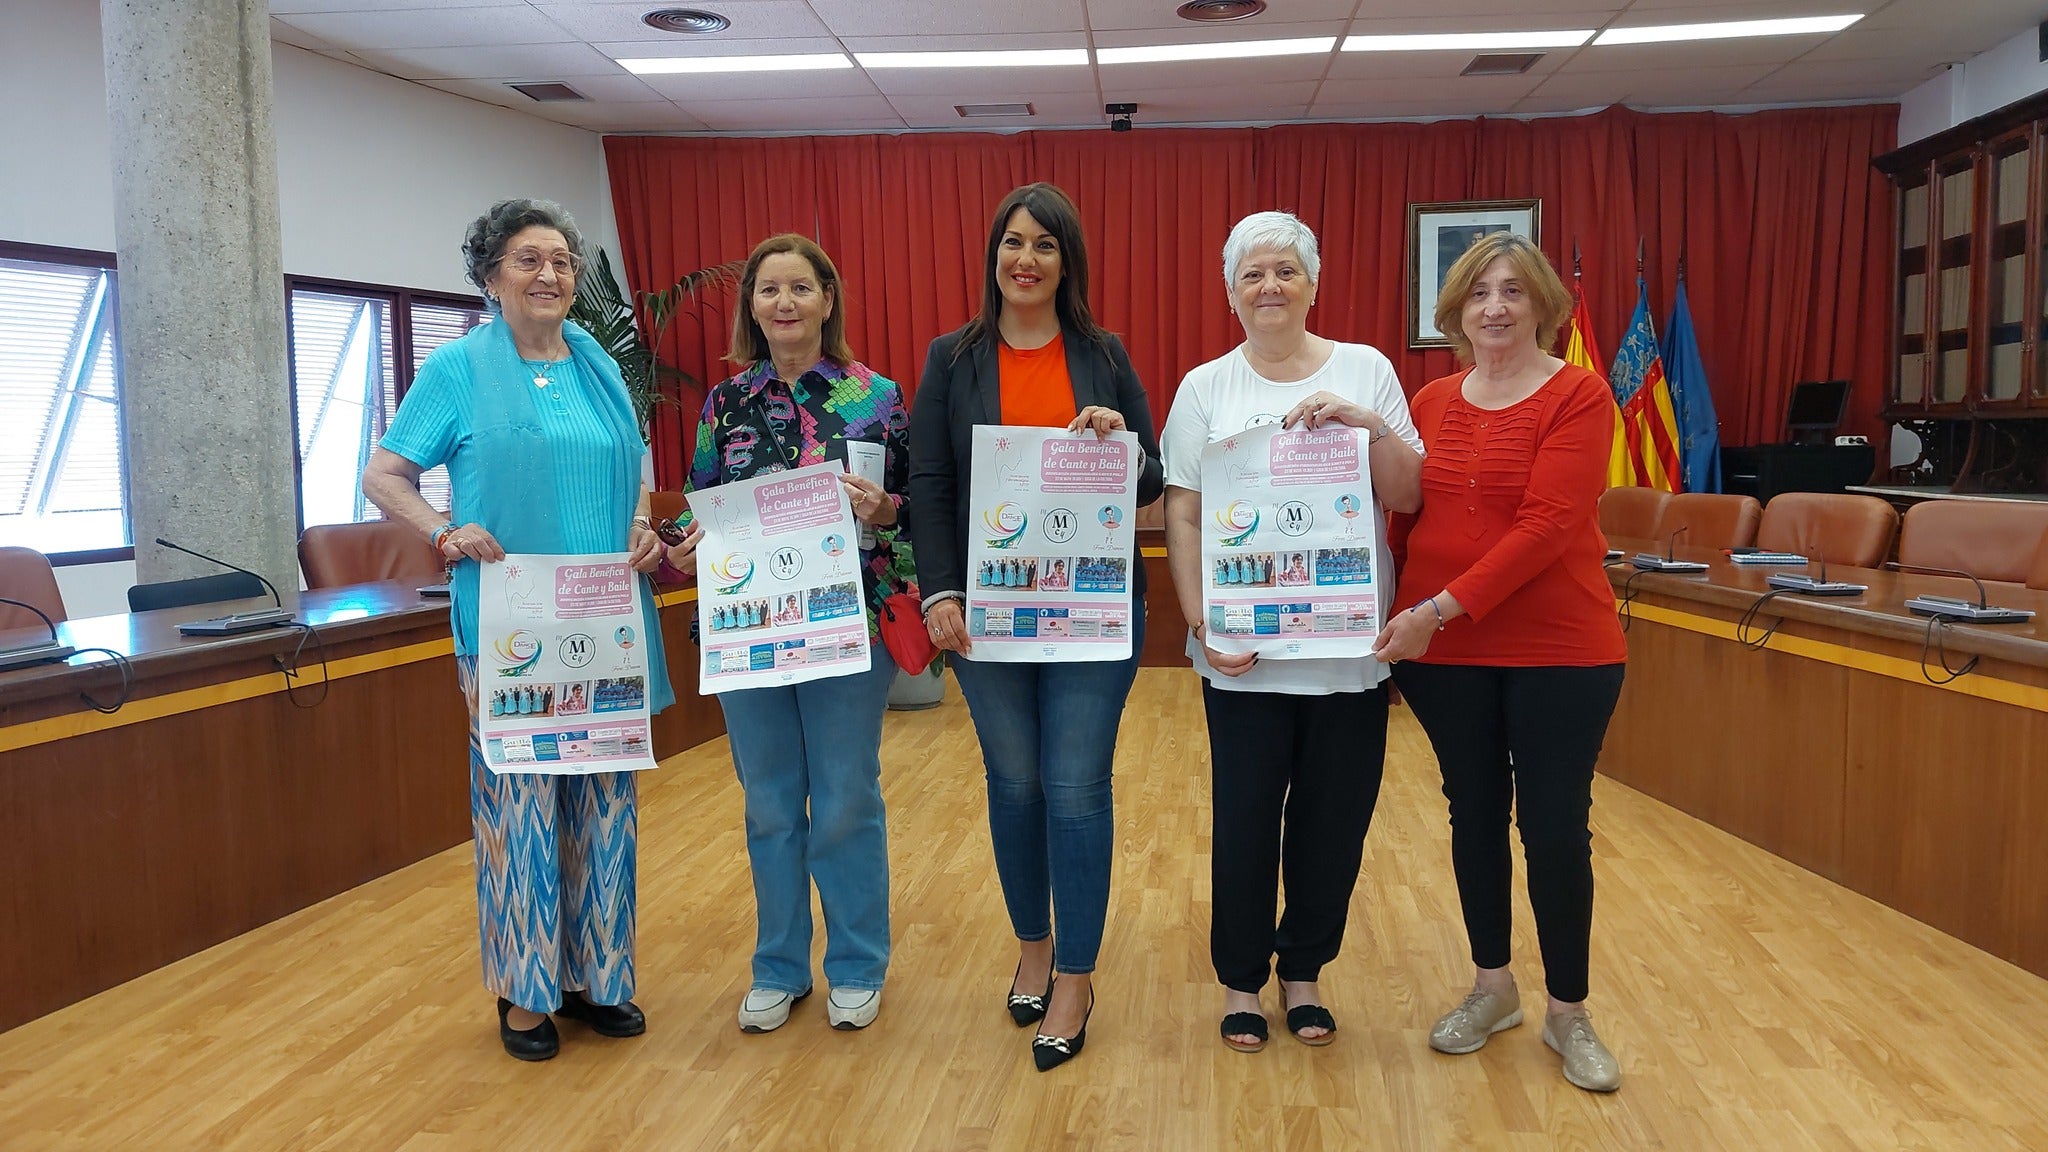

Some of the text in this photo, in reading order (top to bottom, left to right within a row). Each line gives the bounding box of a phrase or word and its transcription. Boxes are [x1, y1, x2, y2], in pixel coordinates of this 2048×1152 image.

[1278, 431, 1350, 449] Gala Benéfica
[1050, 441, 1120, 456] Gala Benéfica
[1272, 446, 1356, 463] de Cante y Baile
[1044, 457, 1126, 471] de Cante y Baile
[762, 476, 829, 500] Gala Benéfica
[760, 501, 773, 514] de
[773, 497, 802, 511] Cante
[804, 497, 811, 507] y
[812, 490, 838, 503] Baile
[1052, 514, 1068, 529] M
[1286, 508, 1302, 522] M
[778, 552, 794, 567] M
[564, 566, 625, 581] Gala Benéfica
[558, 581, 630, 595] de Cante y Baile
[569, 639, 586, 653] M
